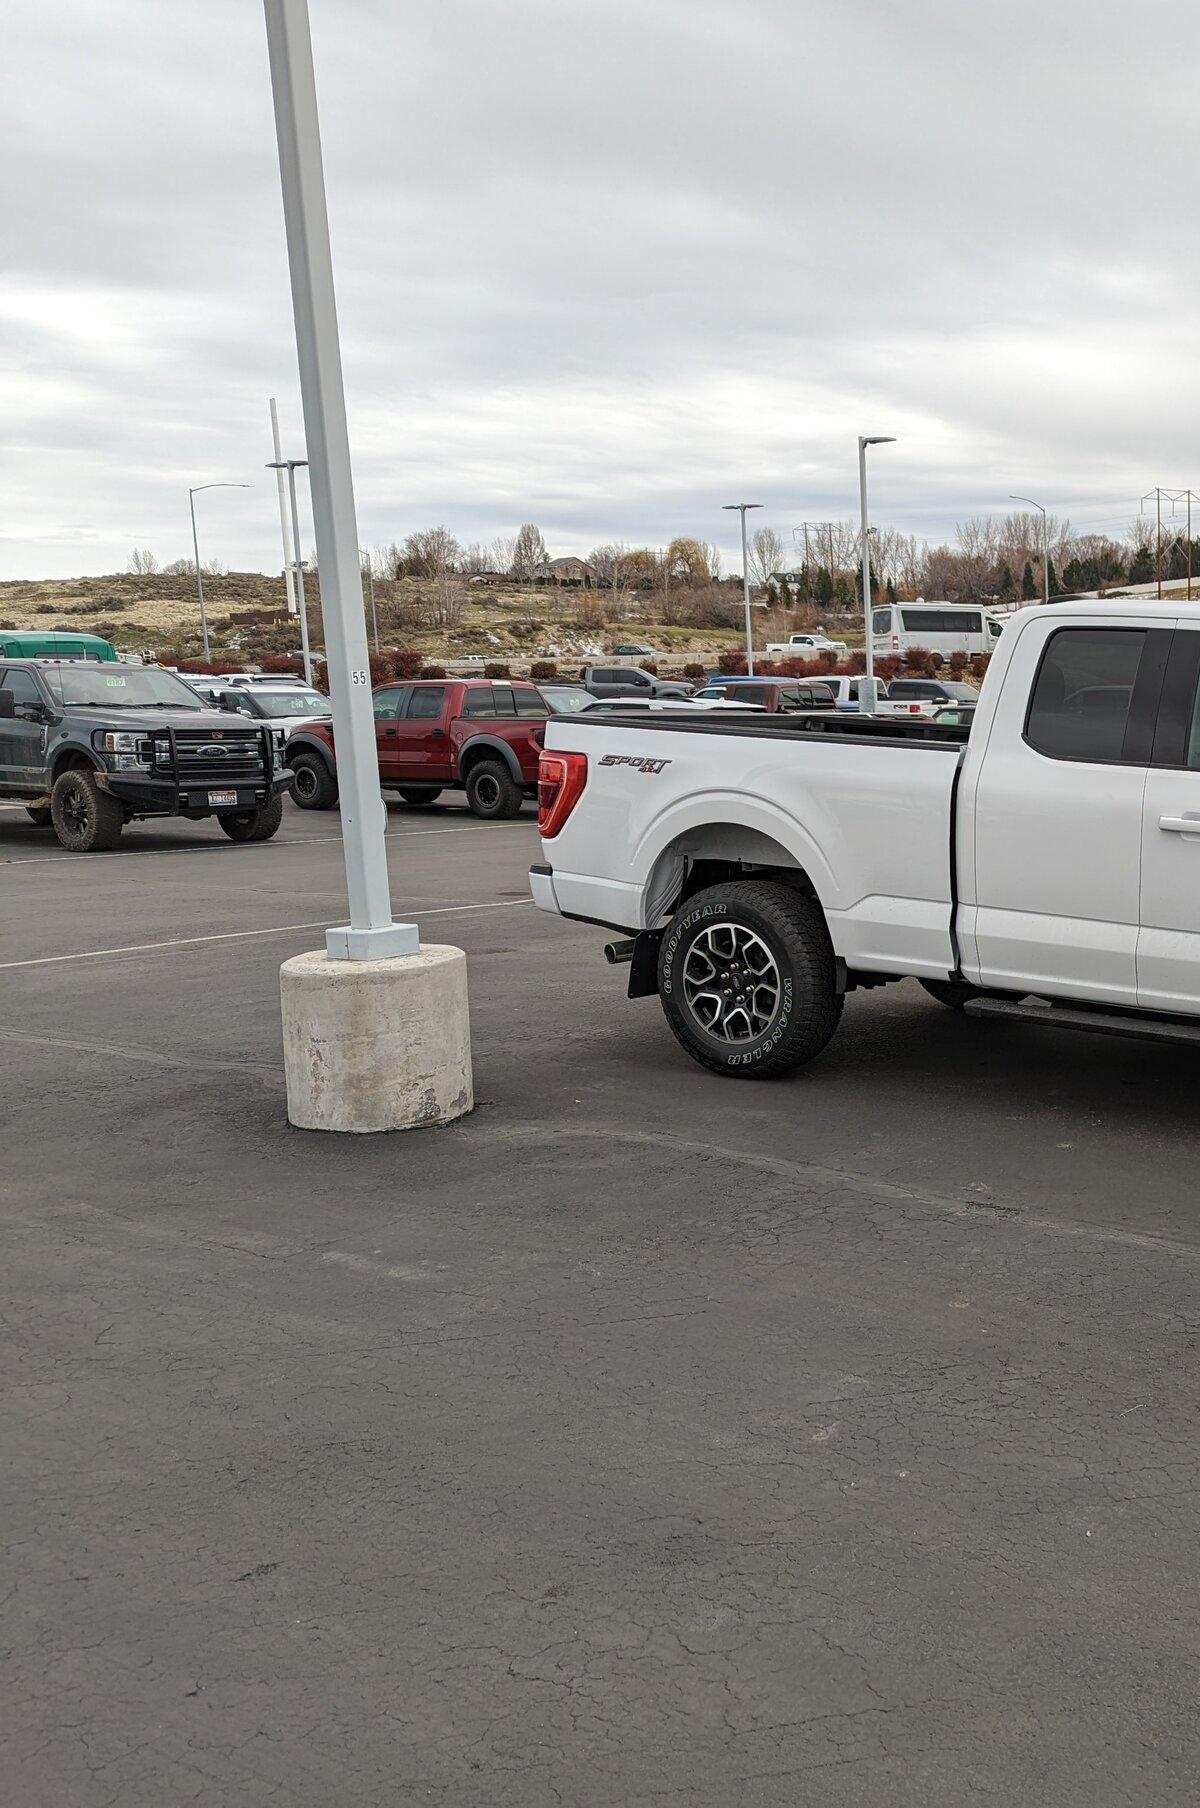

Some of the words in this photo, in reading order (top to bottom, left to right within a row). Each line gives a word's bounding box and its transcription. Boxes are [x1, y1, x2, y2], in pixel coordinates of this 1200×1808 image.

[352, 671, 366, 685] 55
[598, 754, 673, 769] SPORT
[663, 903, 728, 994] GOODYEAR
[728, 977, 793, 1066] WRANGLER
